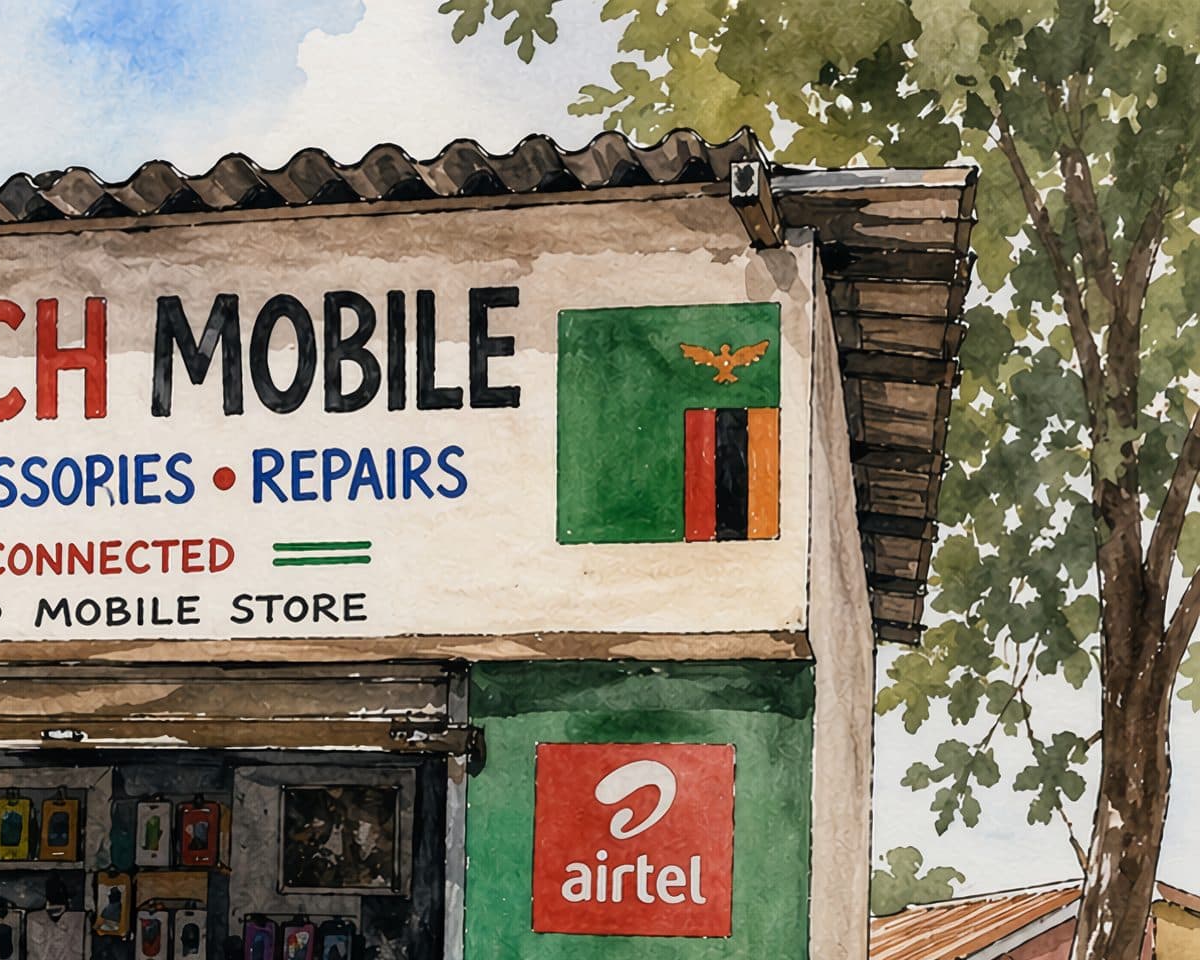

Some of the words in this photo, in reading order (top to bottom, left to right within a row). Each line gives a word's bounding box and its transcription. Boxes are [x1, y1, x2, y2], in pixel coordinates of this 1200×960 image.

[150, 286, 521, 417] MOBILE
[252, 445, 469, 503] REPAIRS
[35, 595, 201, 627] MOBILE
[230, 593, 367, 624] STORE
[562, 850, 706, 905] airtel
